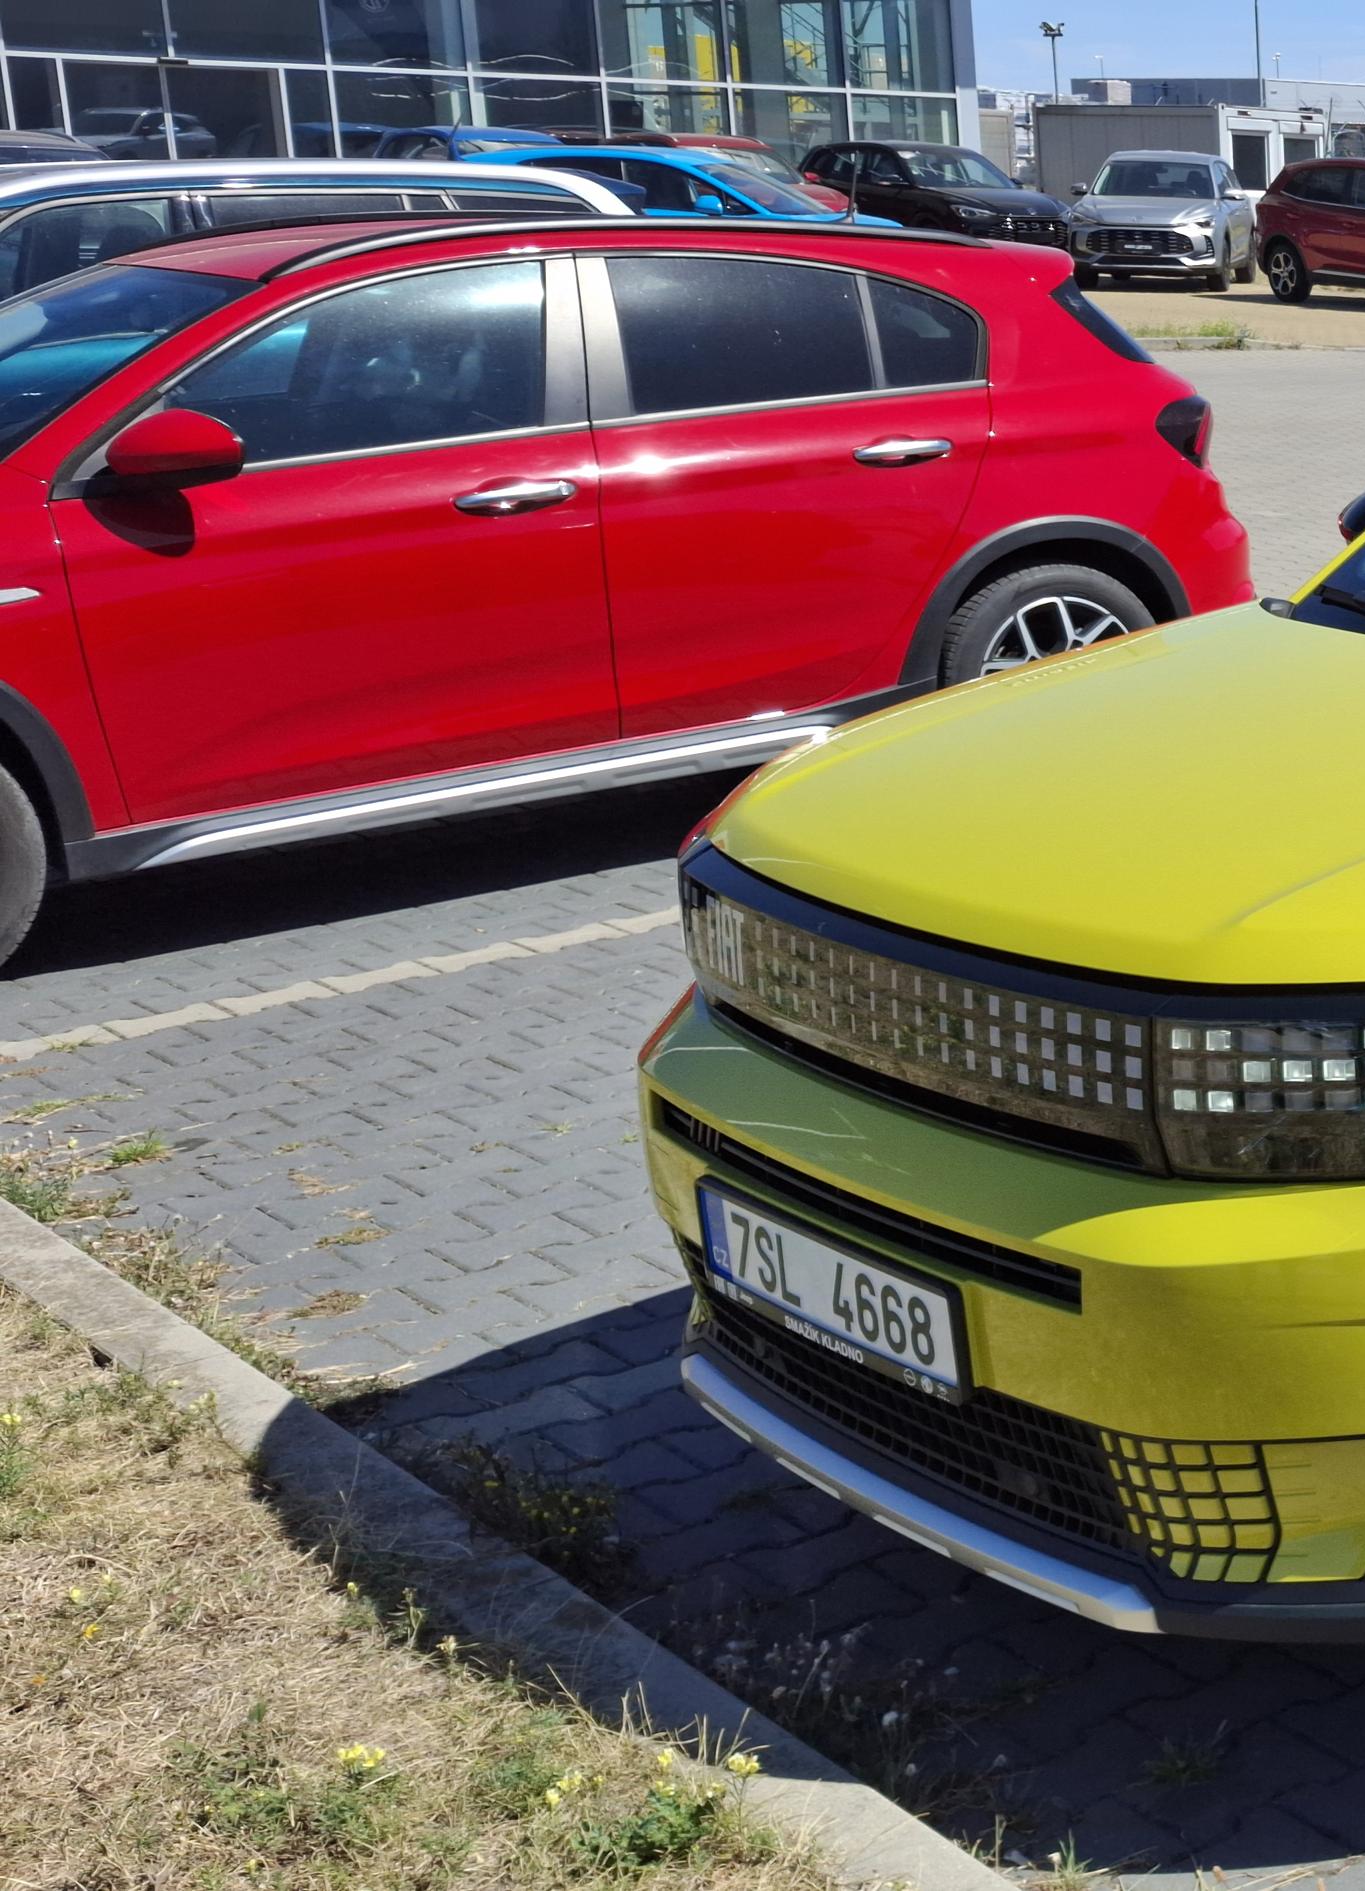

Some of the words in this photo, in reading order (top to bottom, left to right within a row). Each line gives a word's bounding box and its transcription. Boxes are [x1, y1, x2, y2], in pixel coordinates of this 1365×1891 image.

[705, 892, 744, 987] FIAT
[713, 1245, 730, 1268] CZ
[731, 1211, 800, 1308] 7SL
[832, 1261, 935, 1366] 4668
[821, 1334, 864, 1365] KLADNO
